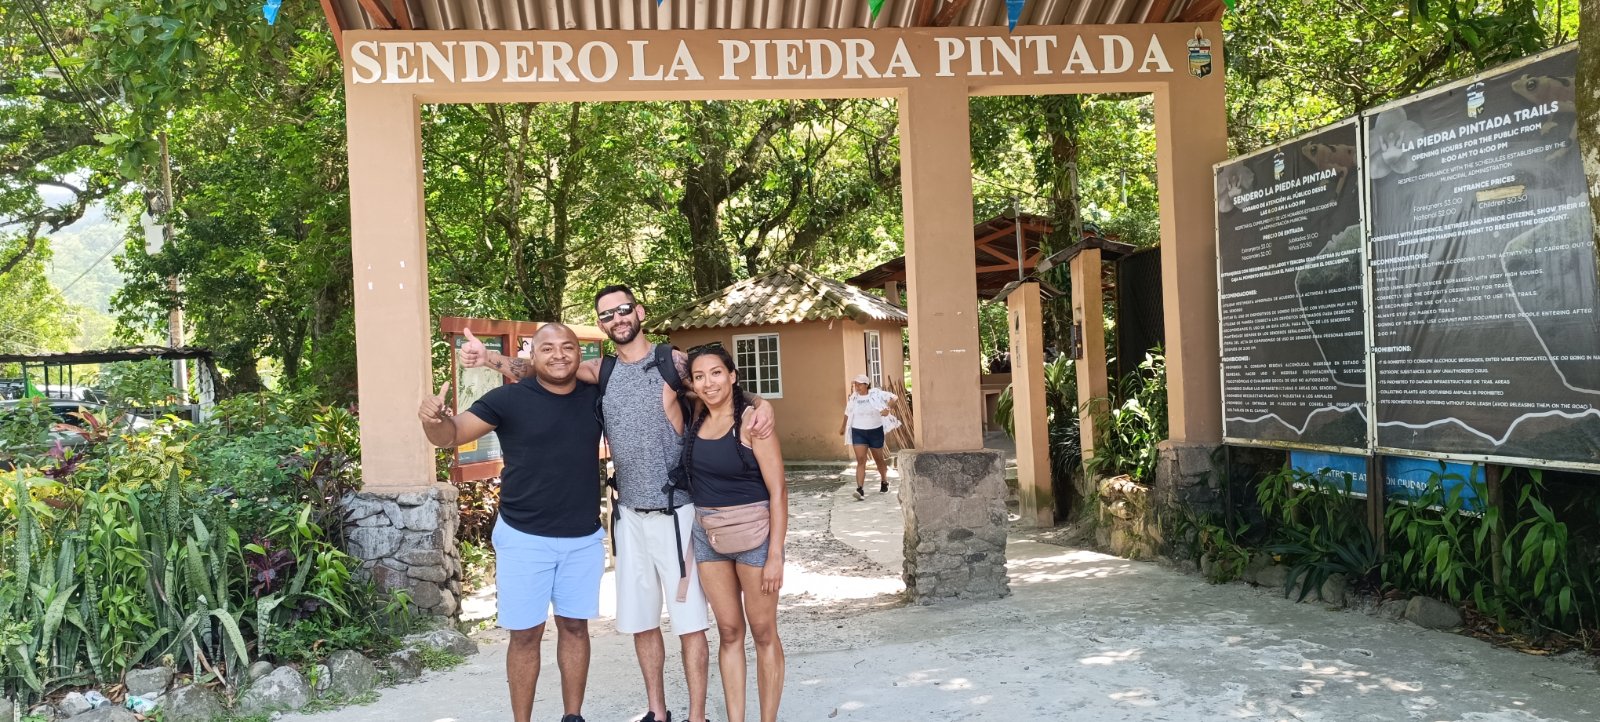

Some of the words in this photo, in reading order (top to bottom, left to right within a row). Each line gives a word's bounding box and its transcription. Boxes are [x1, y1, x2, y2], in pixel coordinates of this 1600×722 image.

[351, 40, 619, 85] SENDERO
[627, 39, 704, 81] LA
[717, 37, 921, 80] PIEDRA
[934, 33, 1174, 77] PINTADA
[1402, 141, 1414, 152] LA
[1417, 129, 1456, 148] PIEDRA
[1459, 114, 1511, 137] PINTADA
[1514, 101, 1559, 123] TRAILS
[1412, 149, 1439, 161] OPENING
[1441, 143, 1462, 154] HOURS
[1464, 139, 1478, 148] FOR
[1479, 135, 1492, 144] THE
[1494, 129, 1519, 140] PUBLIC
[1521, 123, 1541, 134] FROM
[1442, 154, 1457, 163] 8:00
[1498, 142, 1508, 150] PM
[1398, 176, 1417, 185] RESPECT
[1419, 168, 1449, 180] COMPLIANCE
[1451, 165, 1463, 173] WITH
[1475, 155, 1506, 168] SCHEDULES
[1507, 146, 1544, 160] ESTABLISHED
[1554, 141, 1566, 149] THE
[1440, 172, 1467, 183] MUNICIPAL
[1468, 162, 1512, 177] ADMINISTRATION
[1233, 189, 1264, 205] SENDERO
[1265, 186, 1273, 196] LA
[1275, 178, 1301, 193] PIEDRA
[1303, 167, 1336, 185] PINTADA
[1454, 180, 1489, 194] ENTRANCE
[1491, 175, 1515, 186] PRICES
[1242, 204, 1259, 213] HORARIO
[1312, 185, 1326, 194] DESDE
[1414, 202, 1443, 213] Foreigners
[1479, 198, 1505, 209] Children
[1414, 211, 1436, 222] National
[1444, 221, 1469, 230] RETIREES
[1484, 215, 1505, 224] SENIOR
[1507, 210, 1536, 220] CITIZENS,
[1537, 206, 1557, 215] SHOW
[1558, 203, 1577, 212] THEIR
[1458, 227, 1484, 237] PAYMENT
[1495, 221, 1519, 231] RECEIVE
[1534, 213, 1568, 225] DISCOUNT.
